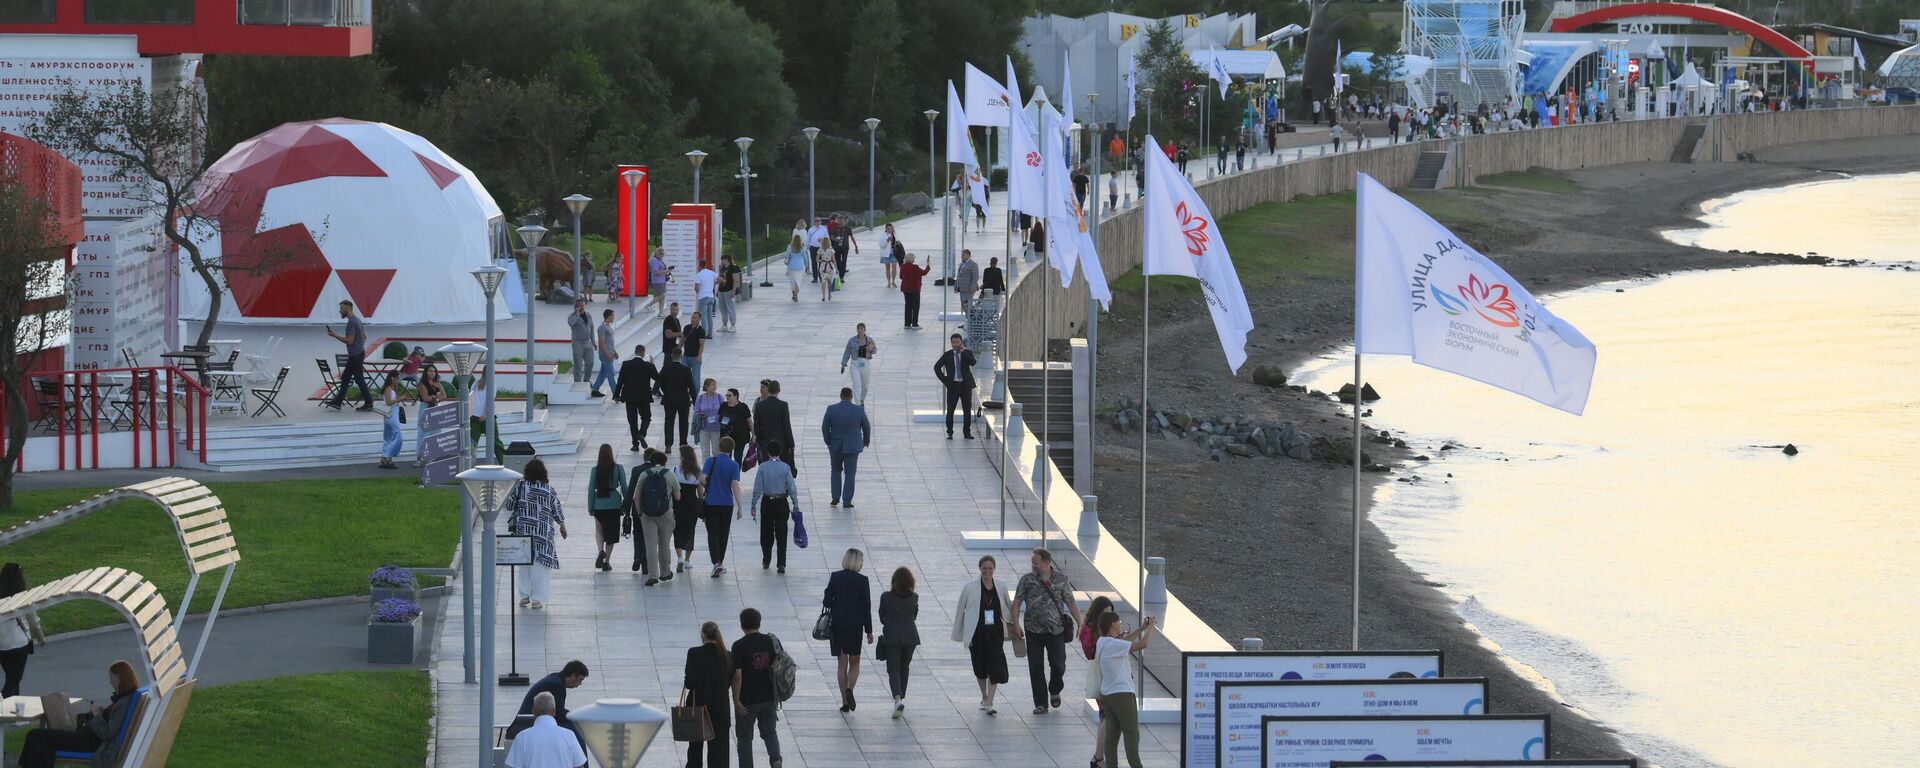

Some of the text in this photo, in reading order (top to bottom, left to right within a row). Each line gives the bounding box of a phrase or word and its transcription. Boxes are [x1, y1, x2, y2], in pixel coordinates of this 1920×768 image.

[82, 191, 128, 199] РОДНЫЕ
[108, 206, 144, 215] КИТАЙ
[89, 271, 110, 279] ГПЗ
[1411, 253, 1437, 312] УЛИЦА
[1448, 320, 1499, 341] ВОСТОЧНЫЙ
[88, 344, 109, 352] ГПЗ
[1444, 338, 1474, 353] ФОРУМ
[1446, 329, 1520, 358] ЭКОНОМИЧЕСКИЙ
[1228, 702, 1246, 710] ШКОЛА
[1278, 701, 1310, 709] НАСТОЛЬНЫХ
[1275, 738, 1301, 746] ТИГРИНЫЕ
[1321, 738, 1346, 746] СЕВЕРНОЕ
[1346, 738, 1374, 746] ПРИМОРЬЕ
[1433, 737, 1453, 745] МЕЧТЫ
